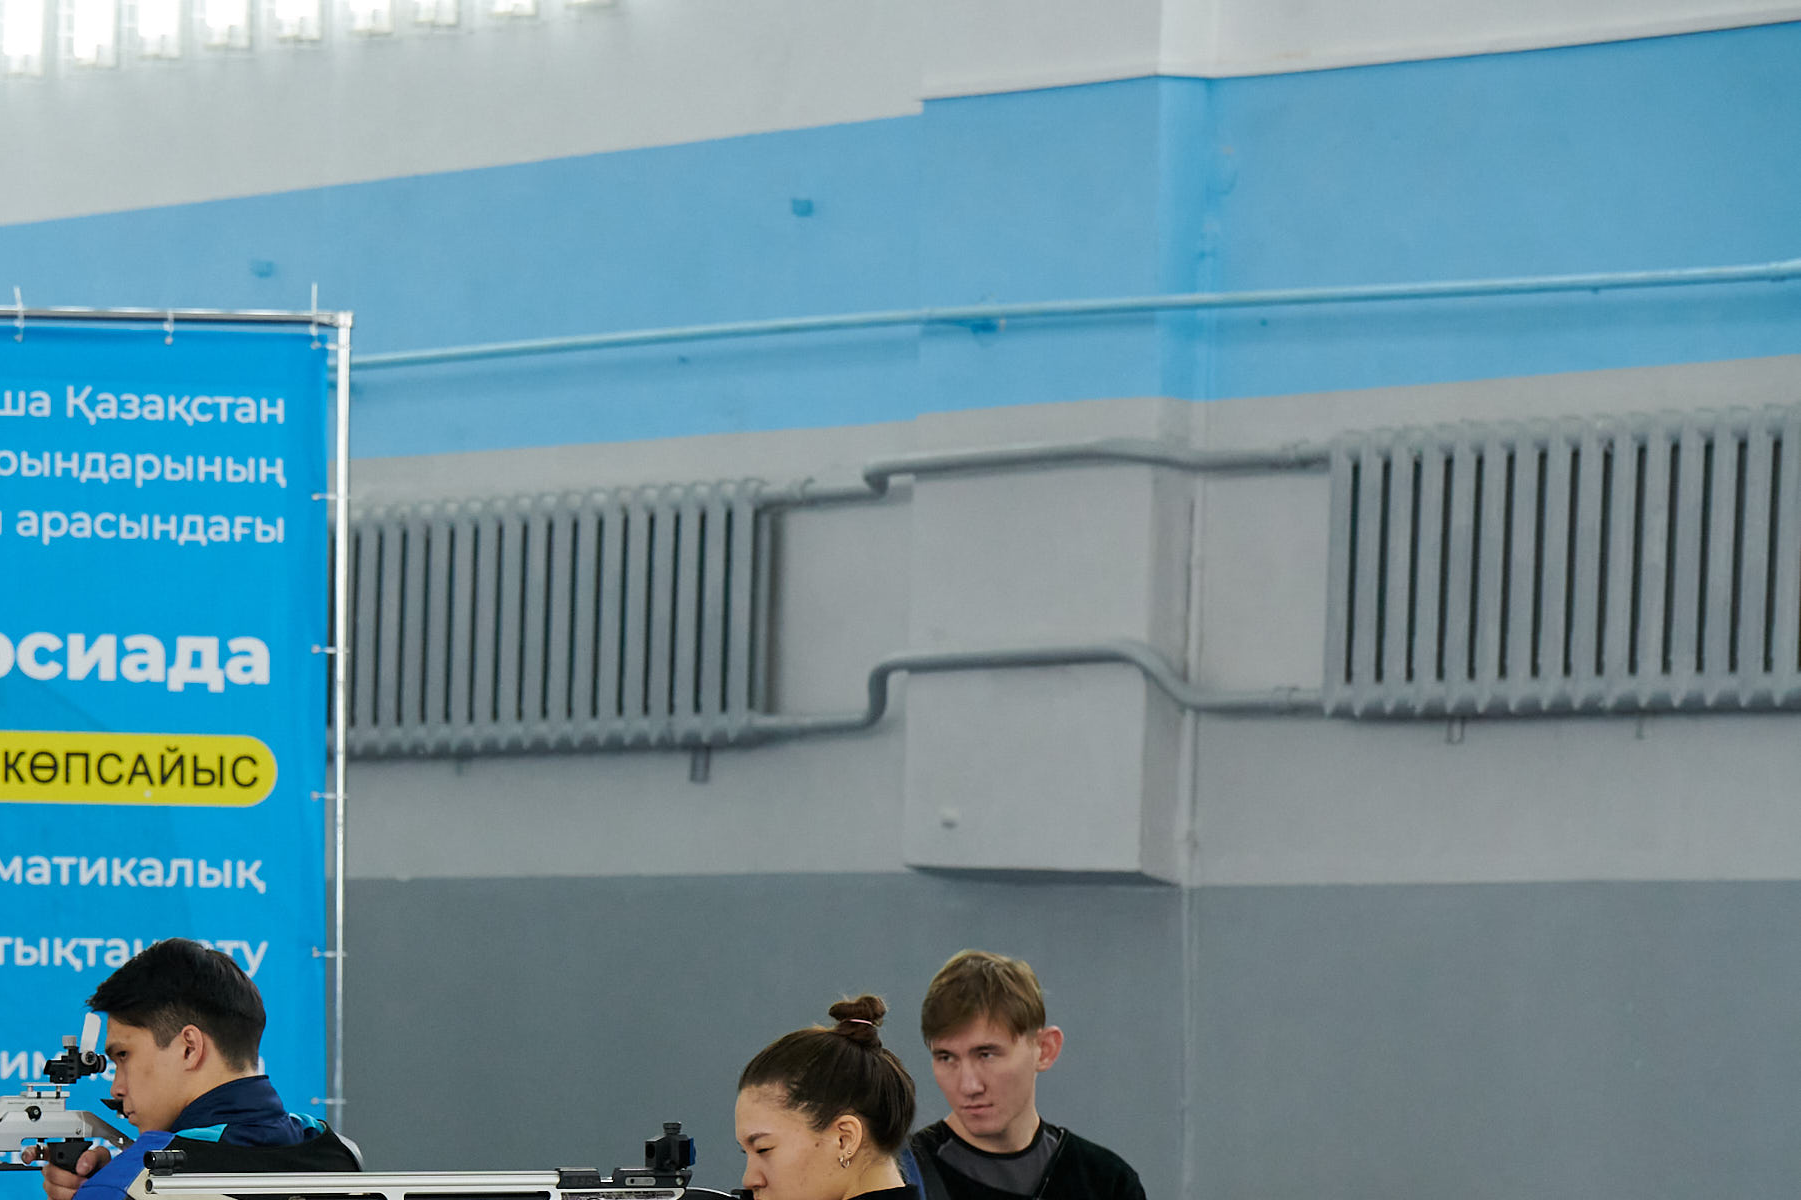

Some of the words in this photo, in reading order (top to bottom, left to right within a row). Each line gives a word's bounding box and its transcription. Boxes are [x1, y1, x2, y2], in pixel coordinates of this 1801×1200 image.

[66, 385, 285, 426] Қазақстан
[16, 510, 285, 546] арасындағы
[4, 744, 258, 788] КӨПСАЙЫС
